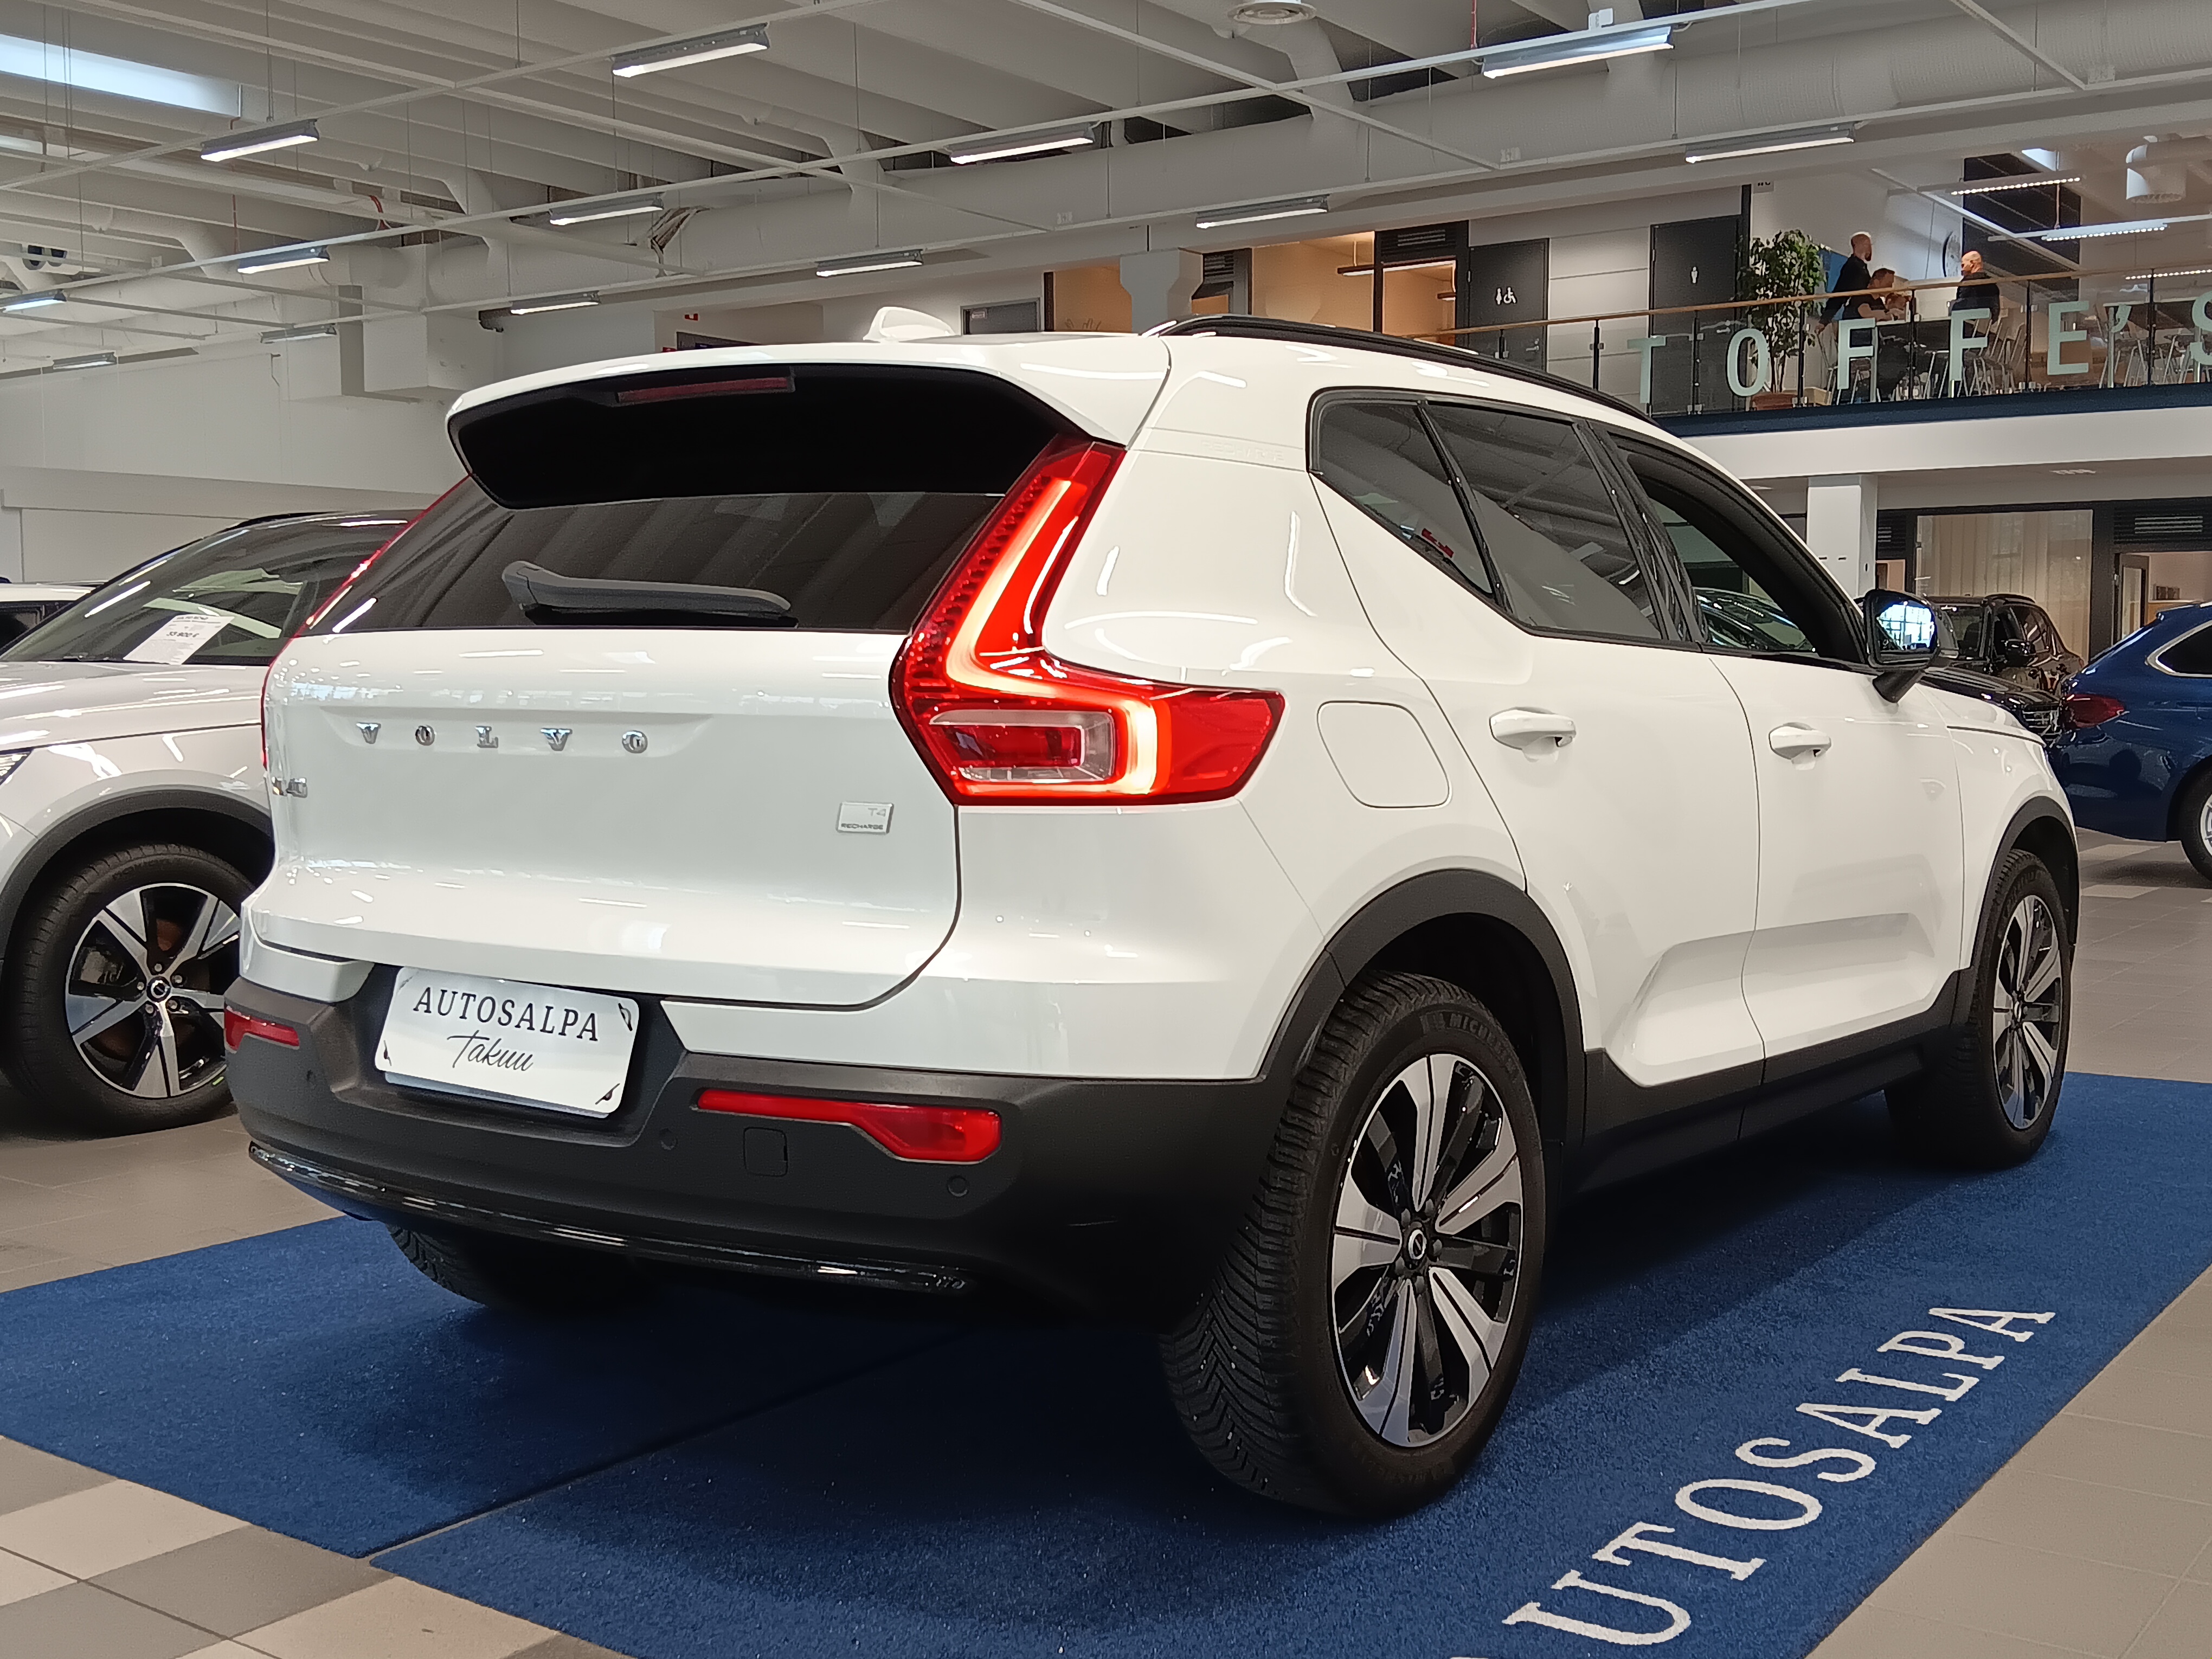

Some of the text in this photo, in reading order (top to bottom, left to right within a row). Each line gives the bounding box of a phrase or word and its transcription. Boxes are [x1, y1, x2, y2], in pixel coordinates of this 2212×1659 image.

[356, 722, 648, 754] VOLVO
[413, 987, 599, 1041] AUTOSALPA
[447, 1030, 534, 1071] Takuu
[1450, 1307, 2056, 1659] UTOSALPA
